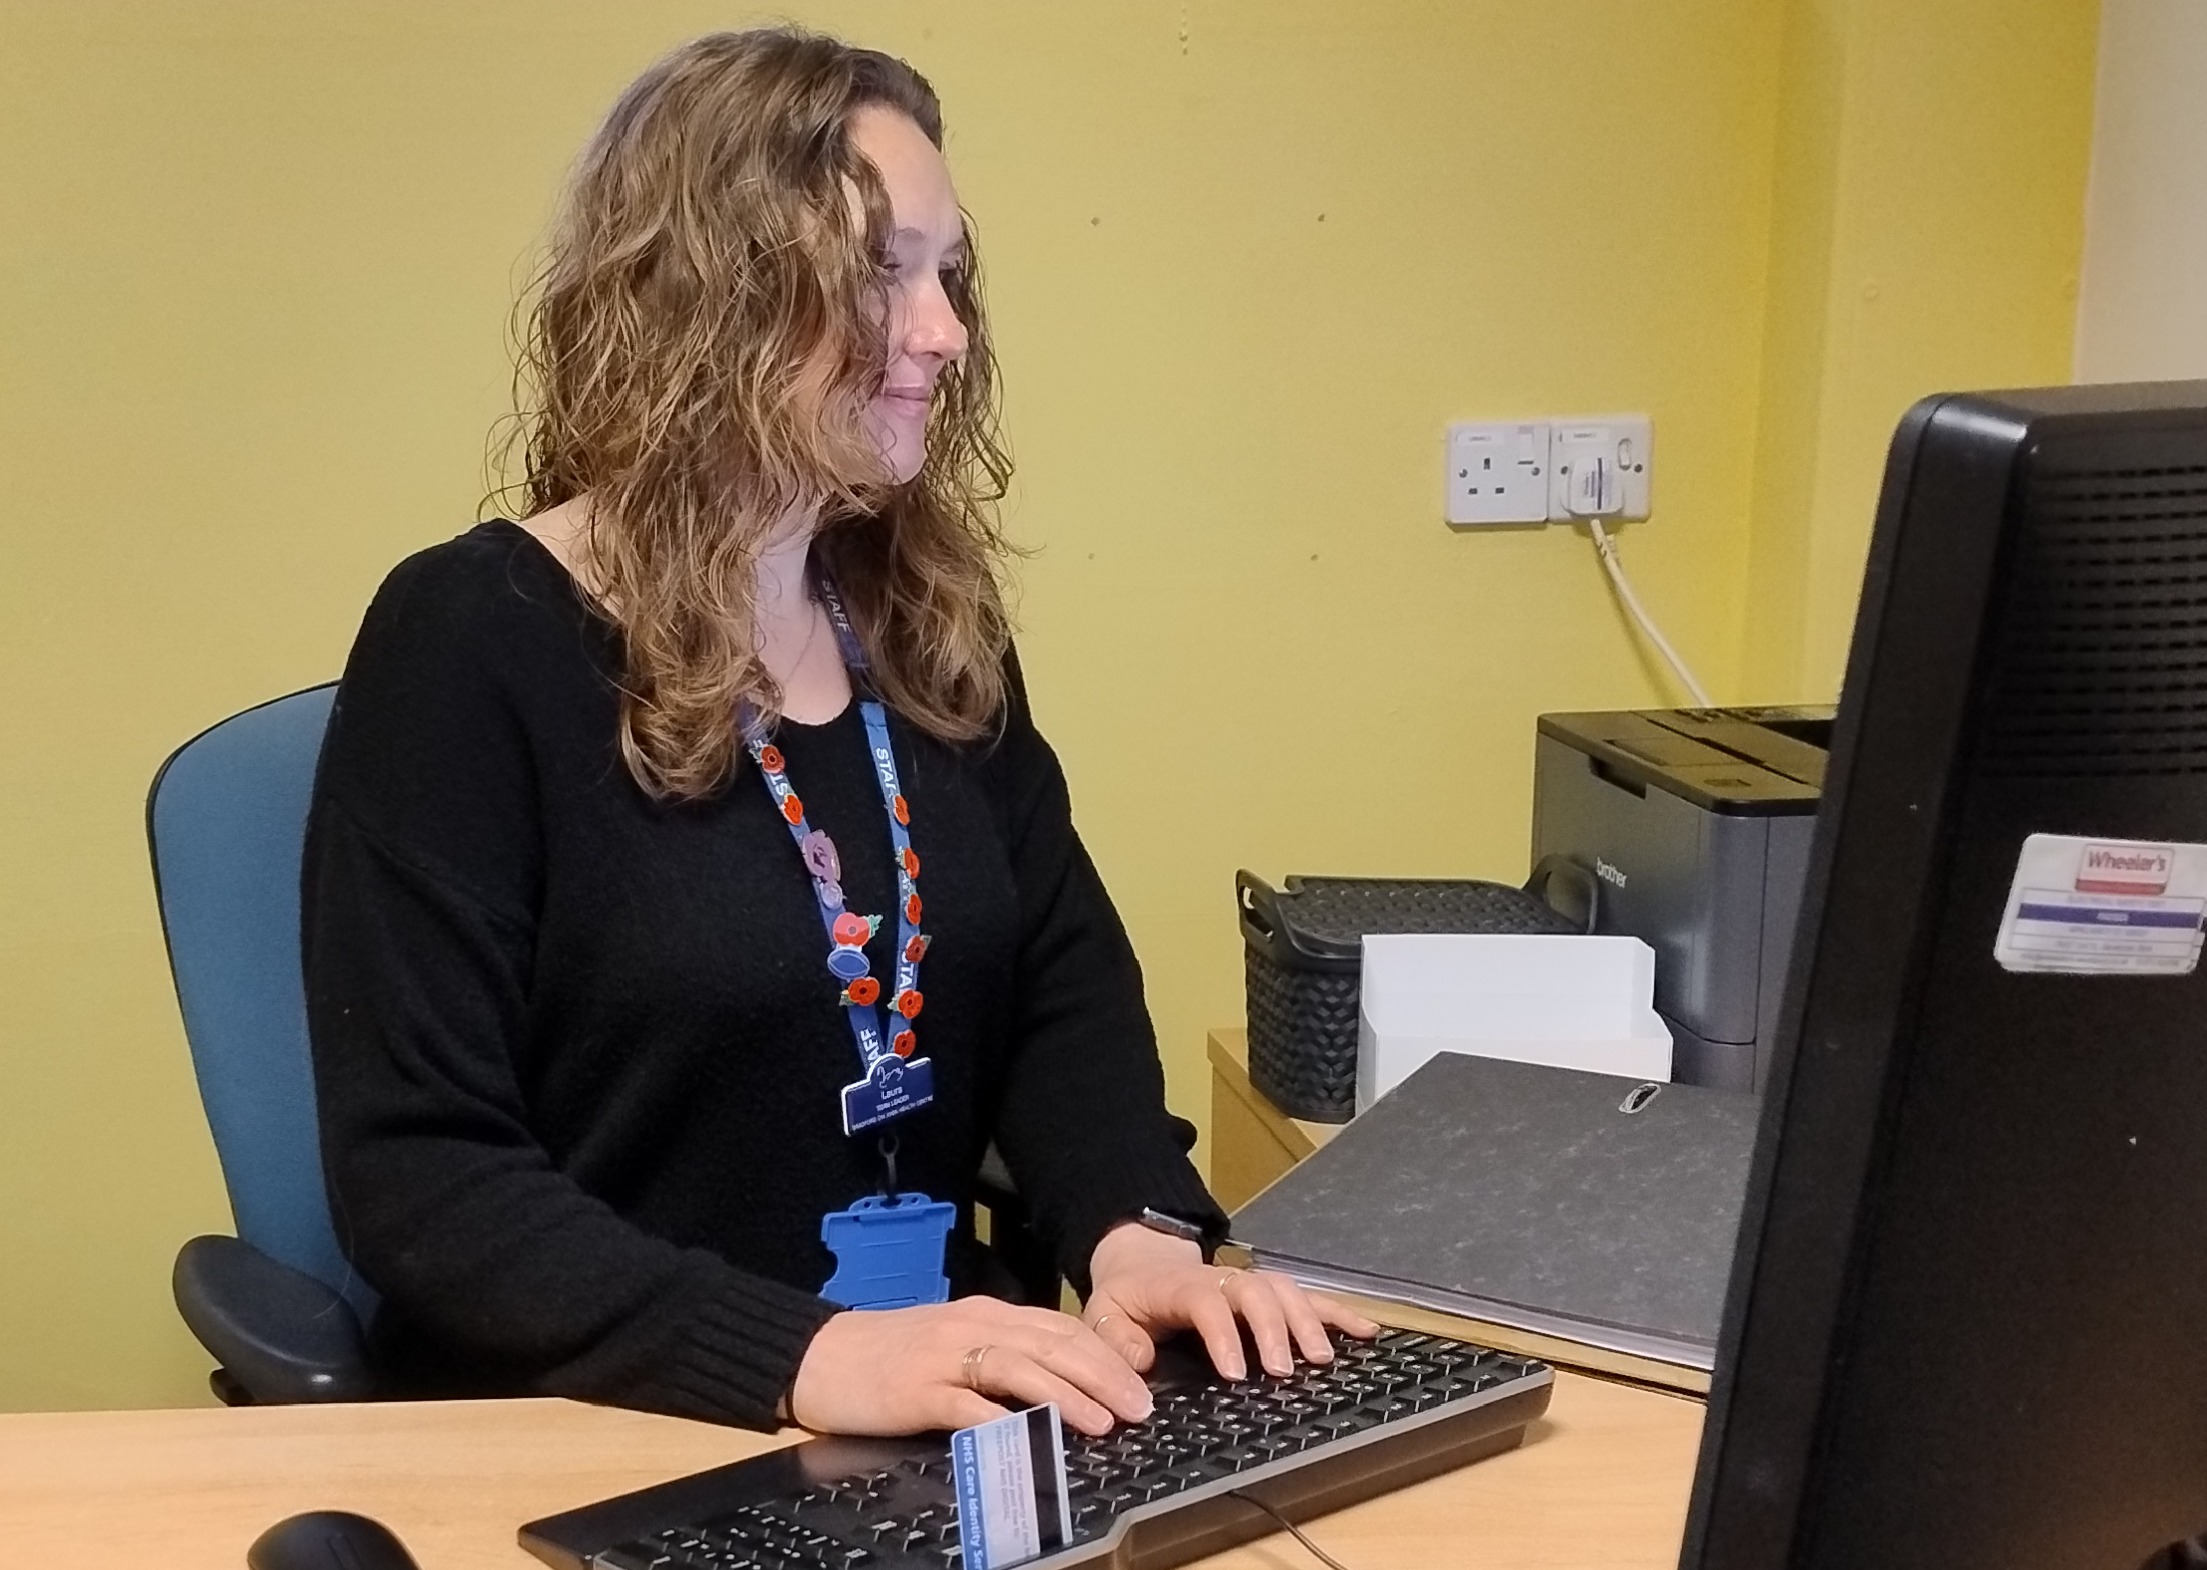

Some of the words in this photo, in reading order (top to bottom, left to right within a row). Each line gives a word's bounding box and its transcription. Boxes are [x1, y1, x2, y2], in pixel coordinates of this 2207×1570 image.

[822, 580, 850, 633] STAFF
[1596, 856, 1628, 889] brother
[2088, 850, 2167, 872] Wheeler's
[962, 1436, 974, 1464] NHS
[965, 1466, 975, 1495] Care
[968, 1497, 983, 1547] Identity
